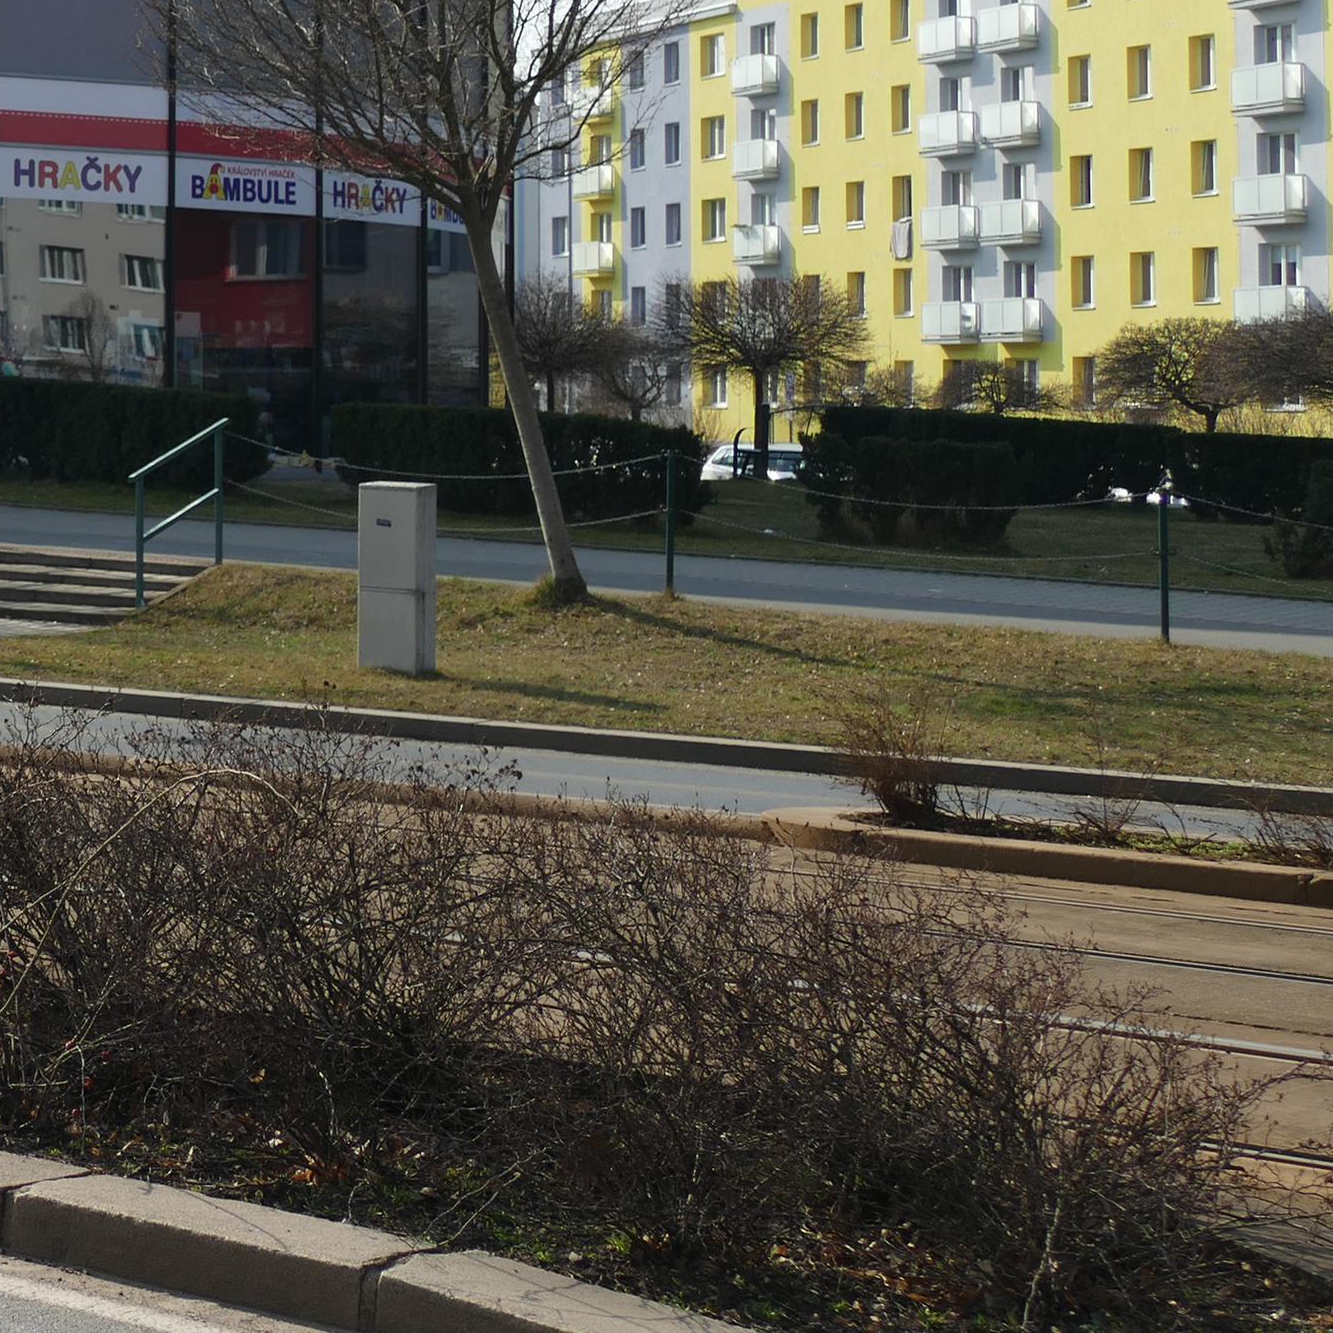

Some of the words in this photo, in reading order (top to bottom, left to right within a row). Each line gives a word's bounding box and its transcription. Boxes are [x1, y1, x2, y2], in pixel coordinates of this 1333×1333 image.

[14, 156, 142, 193] HRAČKY
[191, 173, 297, 205] BAMBULE
[334, 179, 407, 214] HRAČKY
